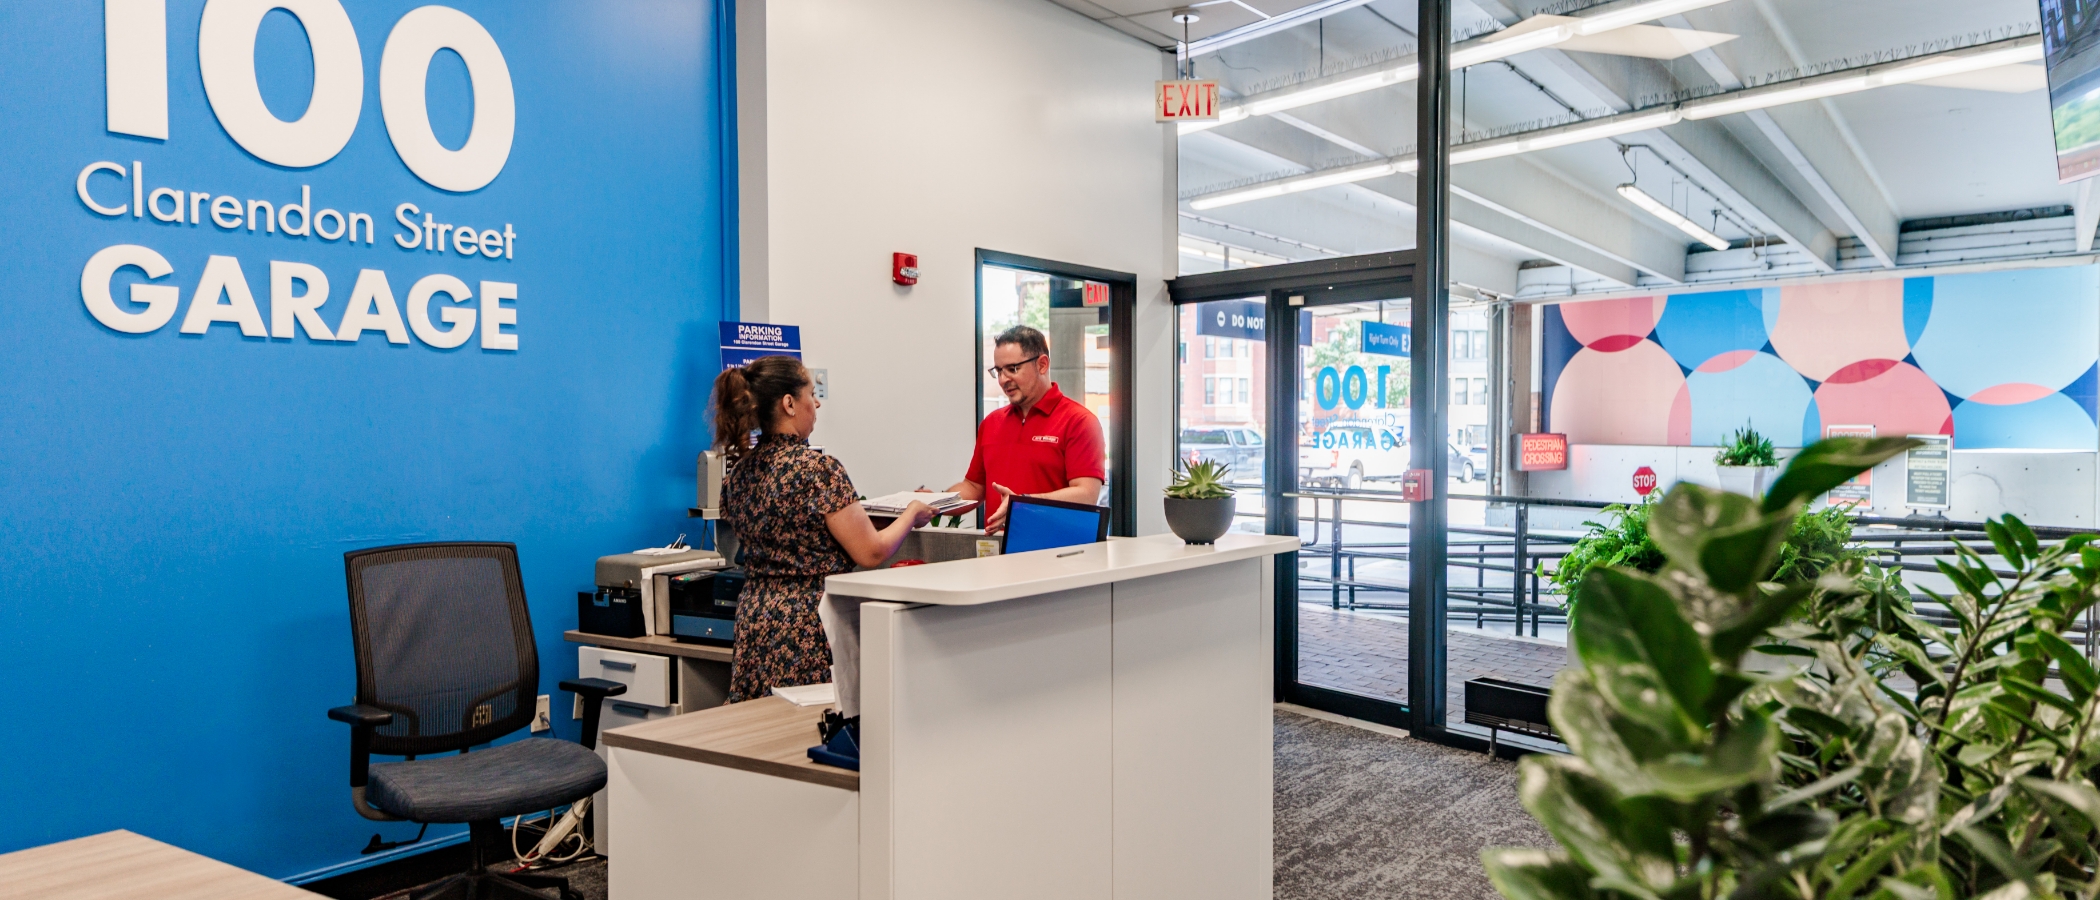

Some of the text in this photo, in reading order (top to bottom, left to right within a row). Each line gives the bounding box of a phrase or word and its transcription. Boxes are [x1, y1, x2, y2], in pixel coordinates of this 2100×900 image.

[103, 0, 517, 193] 100
[1163, 83, 1215, 117] EXIT
[76, 160, 517, 260] Clarendon Street
[80, 243, 519, 351] GARAGE
[738, 325, 782, 336] PARKING
[1232, 314, 1264, 331] DO NOT
[1369, 333, 1380, 346] Right
[1380, 334, 1388, 344] Turn
[1389, 336, 1398, 348] Only
[1524, 439, 1562, 451] PEDESTRIAN
[1524, 452, 1562, 464] CROSSING
[1634, 474, 1656, 488] STOP
